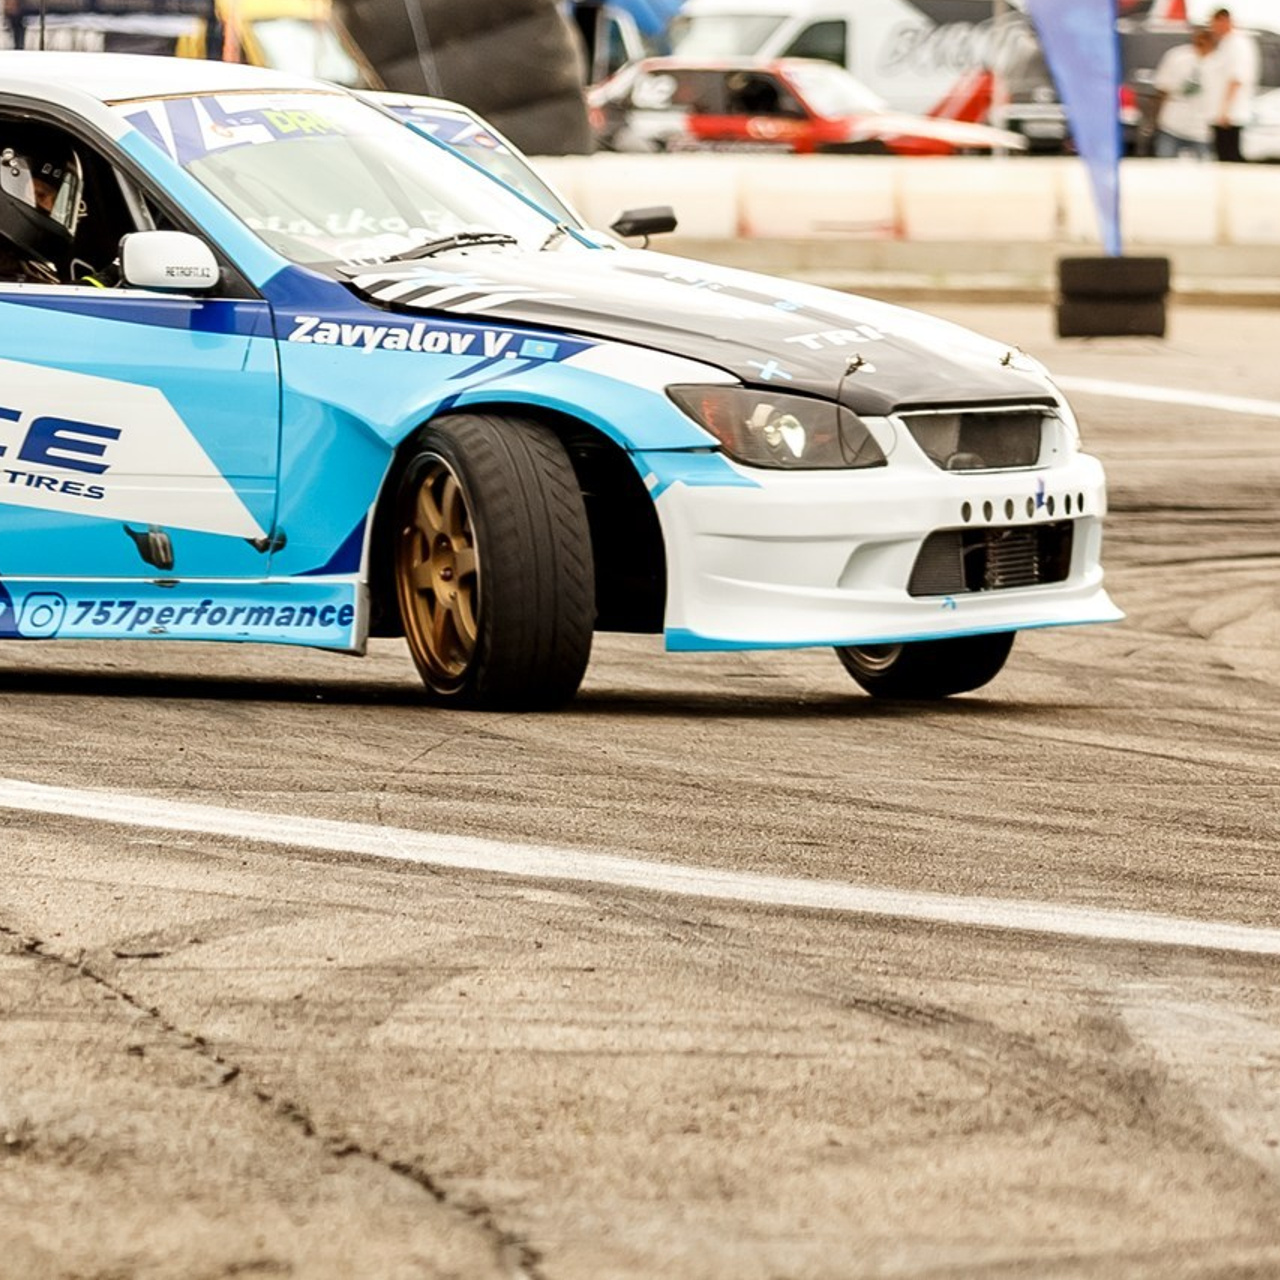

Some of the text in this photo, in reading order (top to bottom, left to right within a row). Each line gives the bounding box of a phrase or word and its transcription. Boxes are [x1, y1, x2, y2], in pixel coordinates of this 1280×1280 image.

[288, 316, 518, 359] Zavyalov V.
[3, 469, 105, 499] TIRES
[71, 599, 355, 632] 757performance
